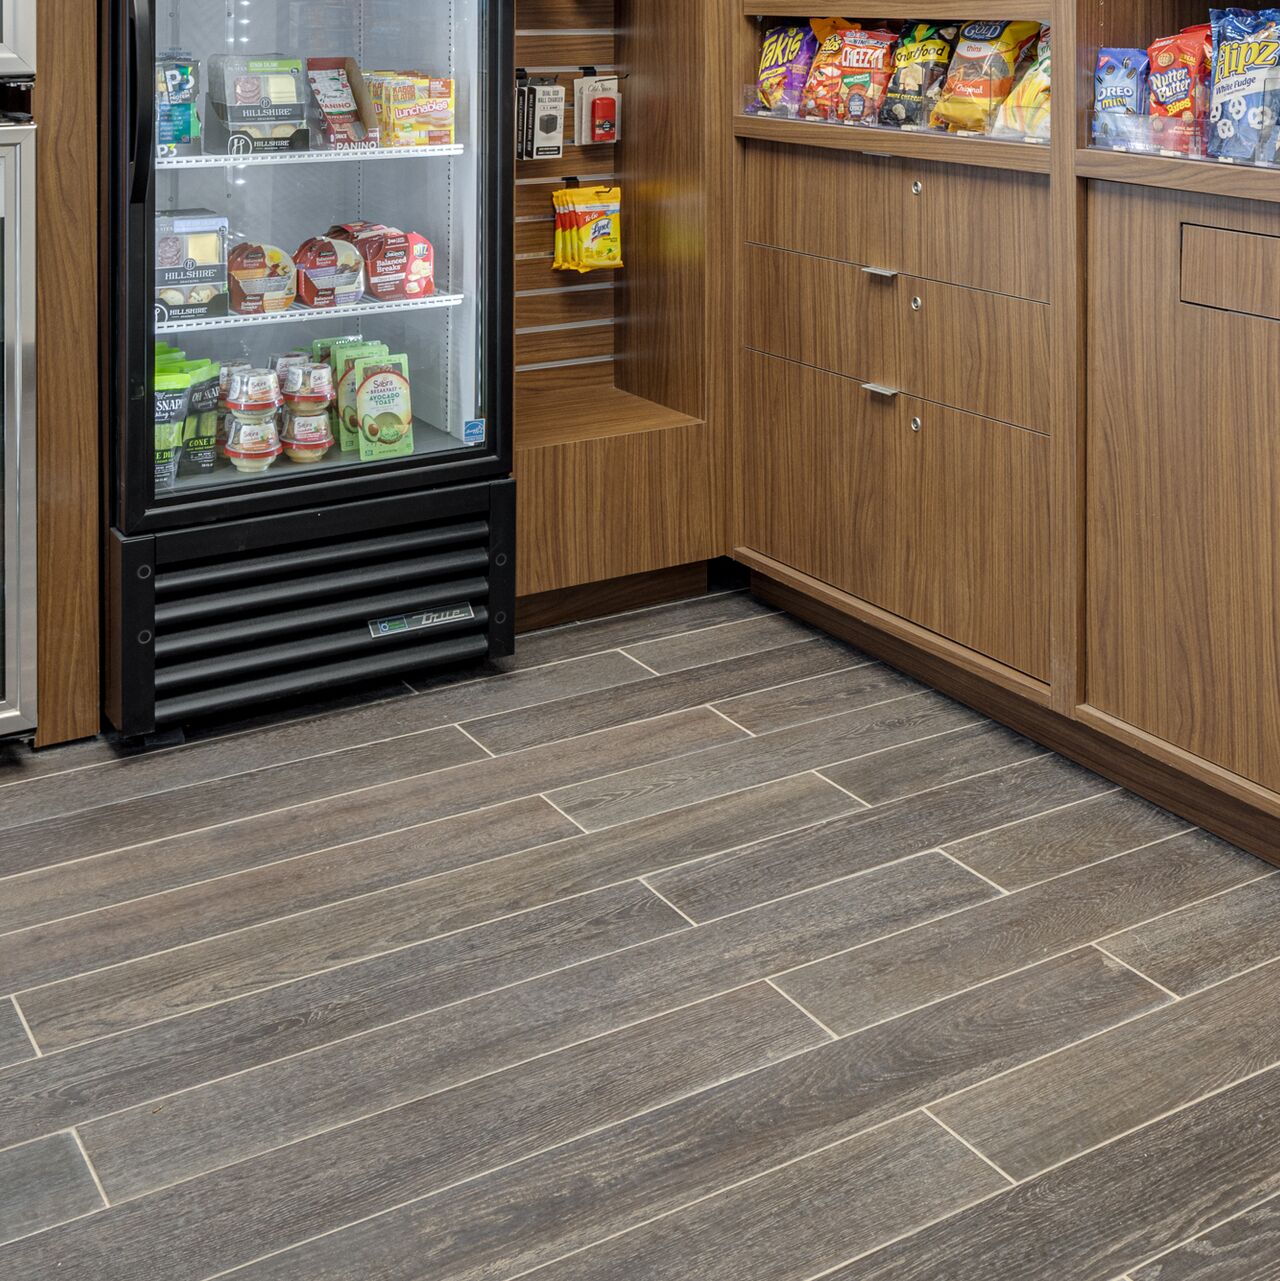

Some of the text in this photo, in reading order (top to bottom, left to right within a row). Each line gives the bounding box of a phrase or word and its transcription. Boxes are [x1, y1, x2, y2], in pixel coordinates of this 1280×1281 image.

[964, 23, 1002, 38] GOLD
[1151, 68, 1190, 89] Nutter
[1158, 78, 1191, 102] Butter
[1216, 76, 1256, 95] White Fudge
[1097, 87, 1133, 100] OREO
[1102, 96, 1127, 108] mini
[1166, 98, 1192, 116] Bites
[243, 109, 292, 117] HILLSHIRE
[395, 100, 448, 119] Lunchables
[254, 139, 289, 147] HILLSHIRE
[336, 141, 377, 151] PANINO
[592, 220, 611, 235] Lysol
[376, 257, 407, 267] Balanced
[377, 264, 401, 274] Breaks
[165, 271, 217, 280] HILLSHIRE
[373, 379, 394, 388] Sabra
[369, 393, 400, 402] AVOCADO
[375, 398, 395, 406] TOAST
